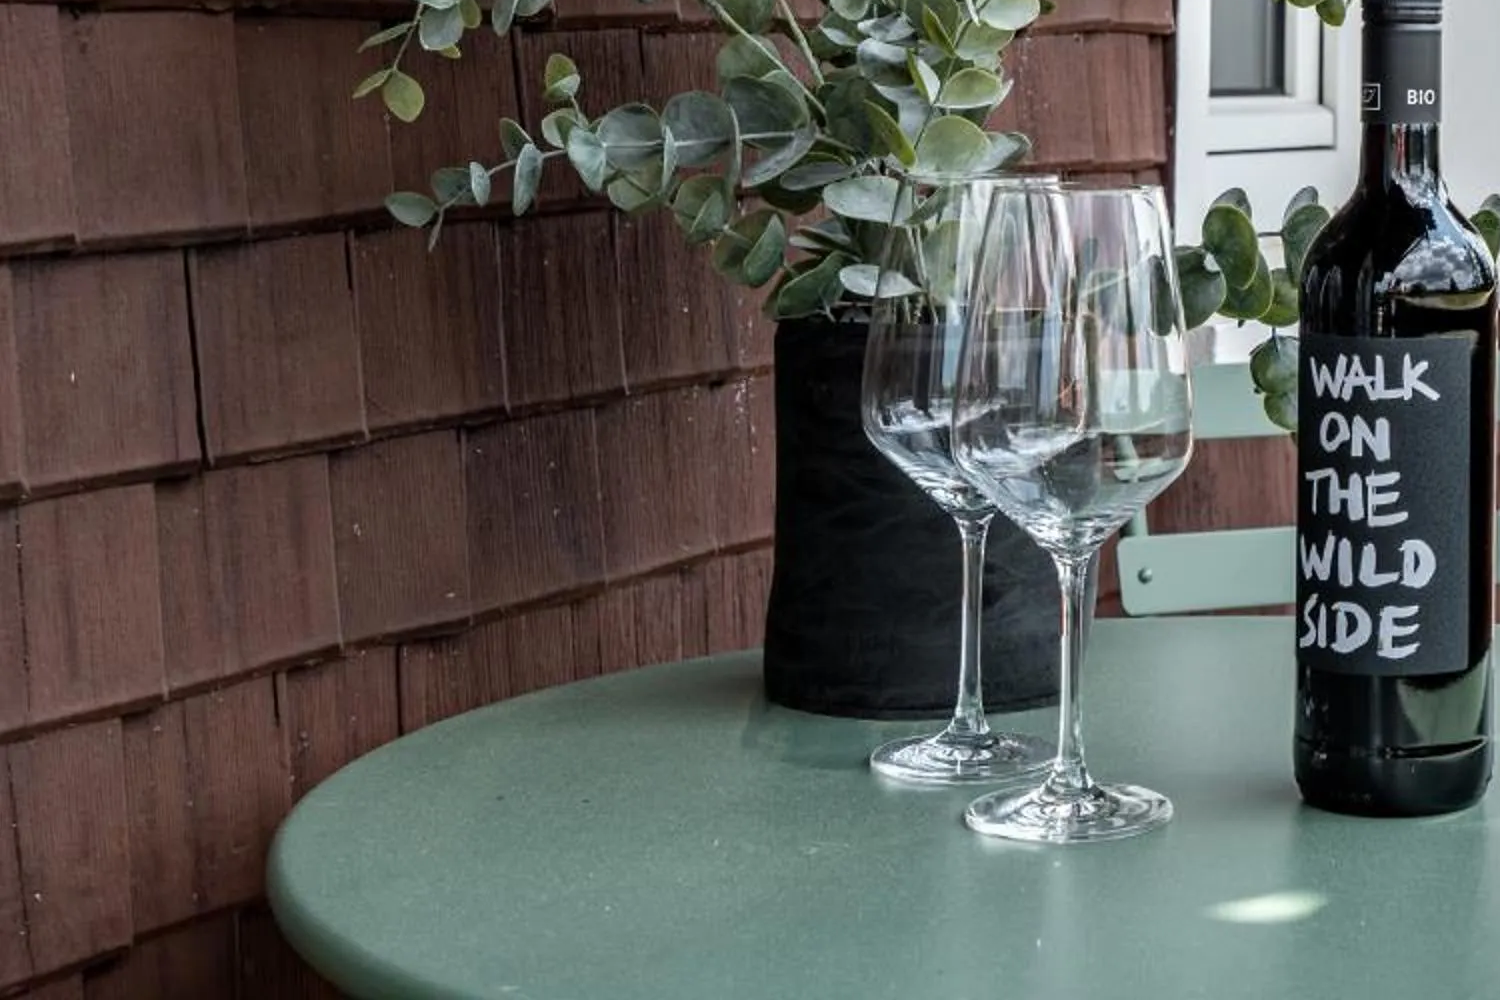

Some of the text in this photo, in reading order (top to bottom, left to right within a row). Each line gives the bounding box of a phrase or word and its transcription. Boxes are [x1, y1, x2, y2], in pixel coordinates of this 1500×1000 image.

[1407, 89, 1435, 105] BIO
[1310, 353, 1440, 401] WALK
[1320, 412, 1391, 461] ON
[1305, 468, 1408, 527] THE
[1301, 533, 1437, 588] WILD
[1299, 594, 1420, 658] SIDE
